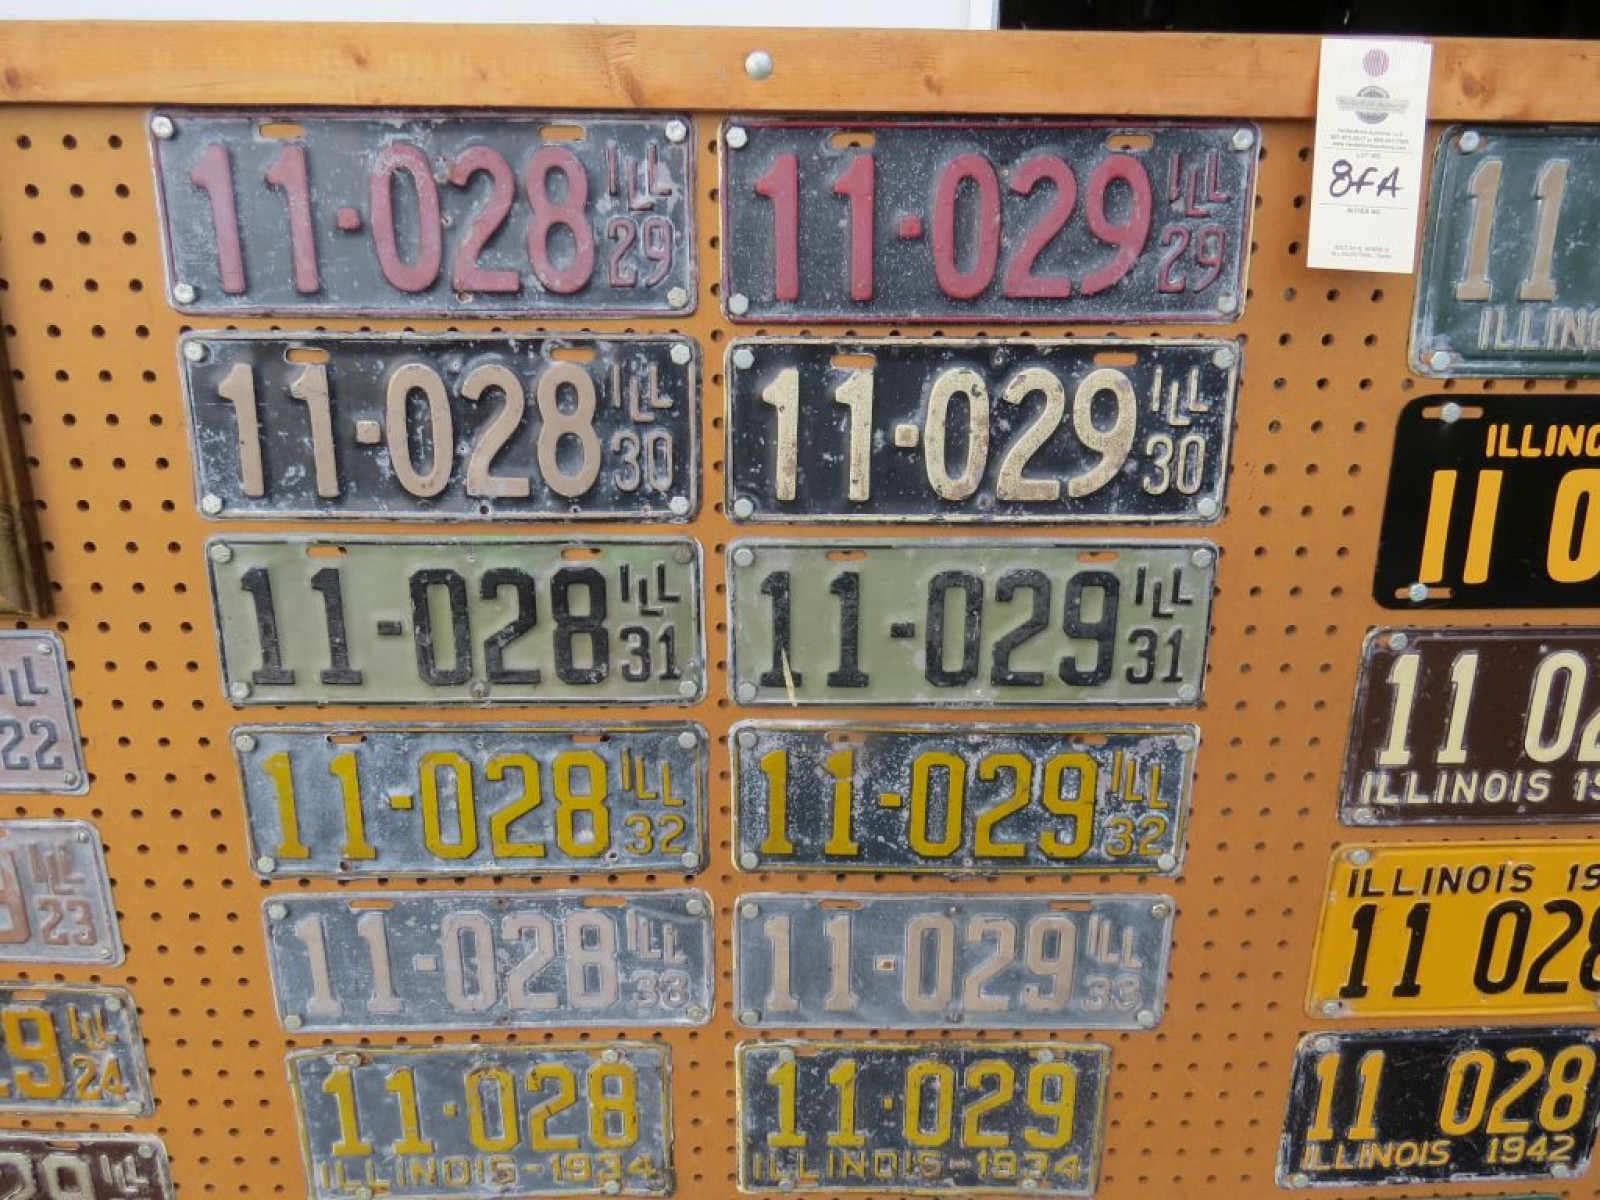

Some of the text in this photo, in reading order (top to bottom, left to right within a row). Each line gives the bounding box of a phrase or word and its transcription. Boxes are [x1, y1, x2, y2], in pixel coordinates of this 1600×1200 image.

[607, 143, 671, 211] ILL
[1169, 152, 1229, 216] ILL
[607, 218, 672, 288] 29
[1456, 159, 1570, 301] 11
[1158, 226, 1225, 294] 29
[612, 362, 672, 422] ILL
[1152, 365, 1208, 426] ILL
[611, 431, 672, 492] 30
[1143, 435, 1204, 496] 30
[620, 563, 680, 616] ILL
[1136, 567, 1192, 618] ILL
[241, 567, 609, 686] 11-028
[620, 626, 681, 682] 31
[760, 570, 1119, 687] 11-029
[1125, 628, 1183, 685] 31
[1378, 654, 1478, 764] 11
[0, 719, 62, 770] 22
[262, 750, 610, 860] 11-028
[621, 749, 685, 806] ILL
[760, 750, 1098, 859] 11-029
[1112, 751, 1170, 809] ILL
[1362, 771, 1550, 804] ILLINOIS
[626, 814, 685, 855] 32
[1104, 816, 1168, 856] 32
[1348, 864, 1535, 897] ILLINOIS
[38, 899, 97, 945] 23
[627, 909, 687, 966] ILL
[1087, 914, 1143, 969] ILL
[1339, 903, 1430, 998] 11
[297, 909, 619, 1016] 11-028
[630, 970, 689, 1009] 33
[1081, 974, 1143, 1011] 33
[72, 1056, 126, 1099] 24
[1307, 1045, 1595, 1140] 11 028
[1303, 1135, 1576, 1170] ILLINOIS 1942
